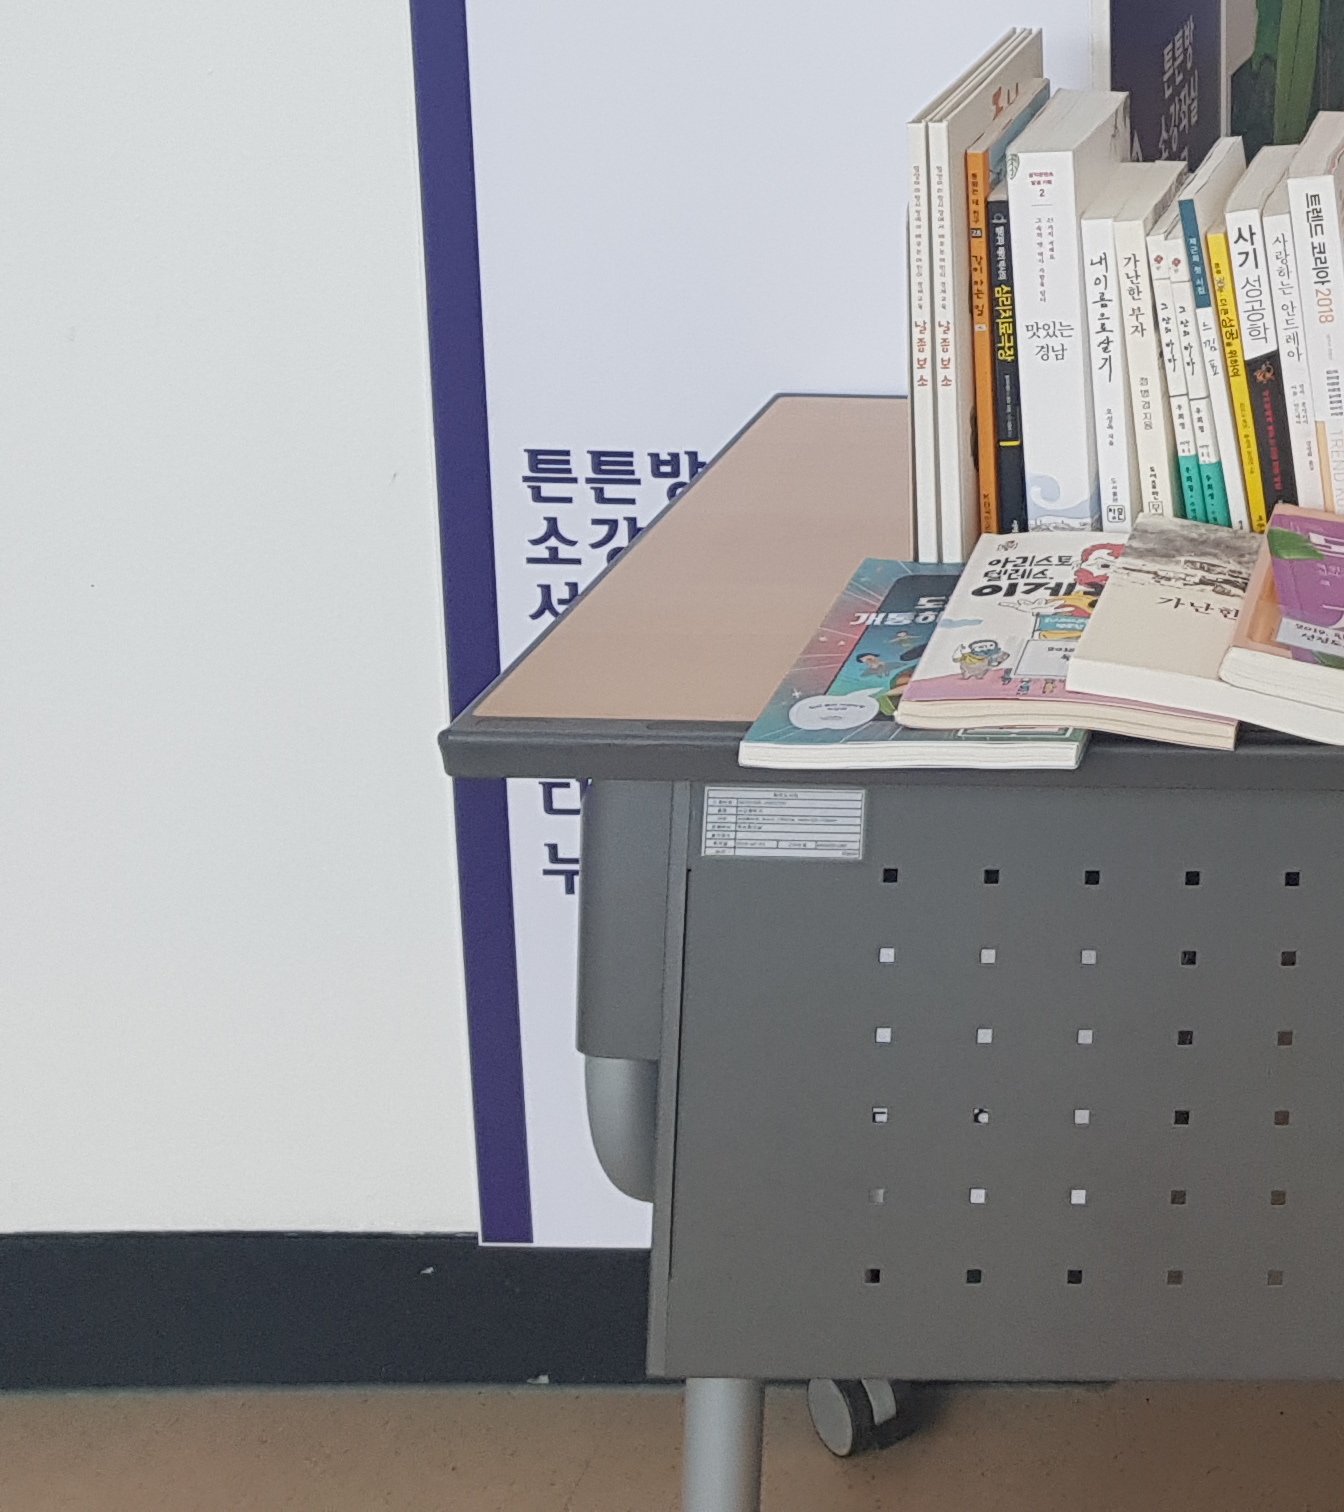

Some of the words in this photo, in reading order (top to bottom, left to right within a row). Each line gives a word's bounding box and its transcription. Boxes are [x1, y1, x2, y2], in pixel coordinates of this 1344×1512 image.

[1162, 14, 1194, 99] 튼튼방
[1306, 192, 1324, 238] 트렌드
[1233, 224, 1259, 270] 사기
[1272, 232, 1294, 296] 사랑하는
[1311, 241, 1331, 285] 코리아
[1123, 253, 1142, 301] 가난한
[994, 284, 1015, 361] 심리치료극장
[1129, 306, 1147, 337] 부자
[1241, 274, 1269, 344] 성공학
[1315, 288, 1334, 324] 2018
[1025, 321, 1074, 339] 맛있는
[1035, 343, 1068, 362] 경남
[1281, 300, 1302, 362] 안드레아
[1228, 350, 1241, 377] 위하여
[522, 449, 706, 505] 튼튼방
[988, 555, 1072, 568] 아리스토
[971, 582, 1078, 598] 이게
